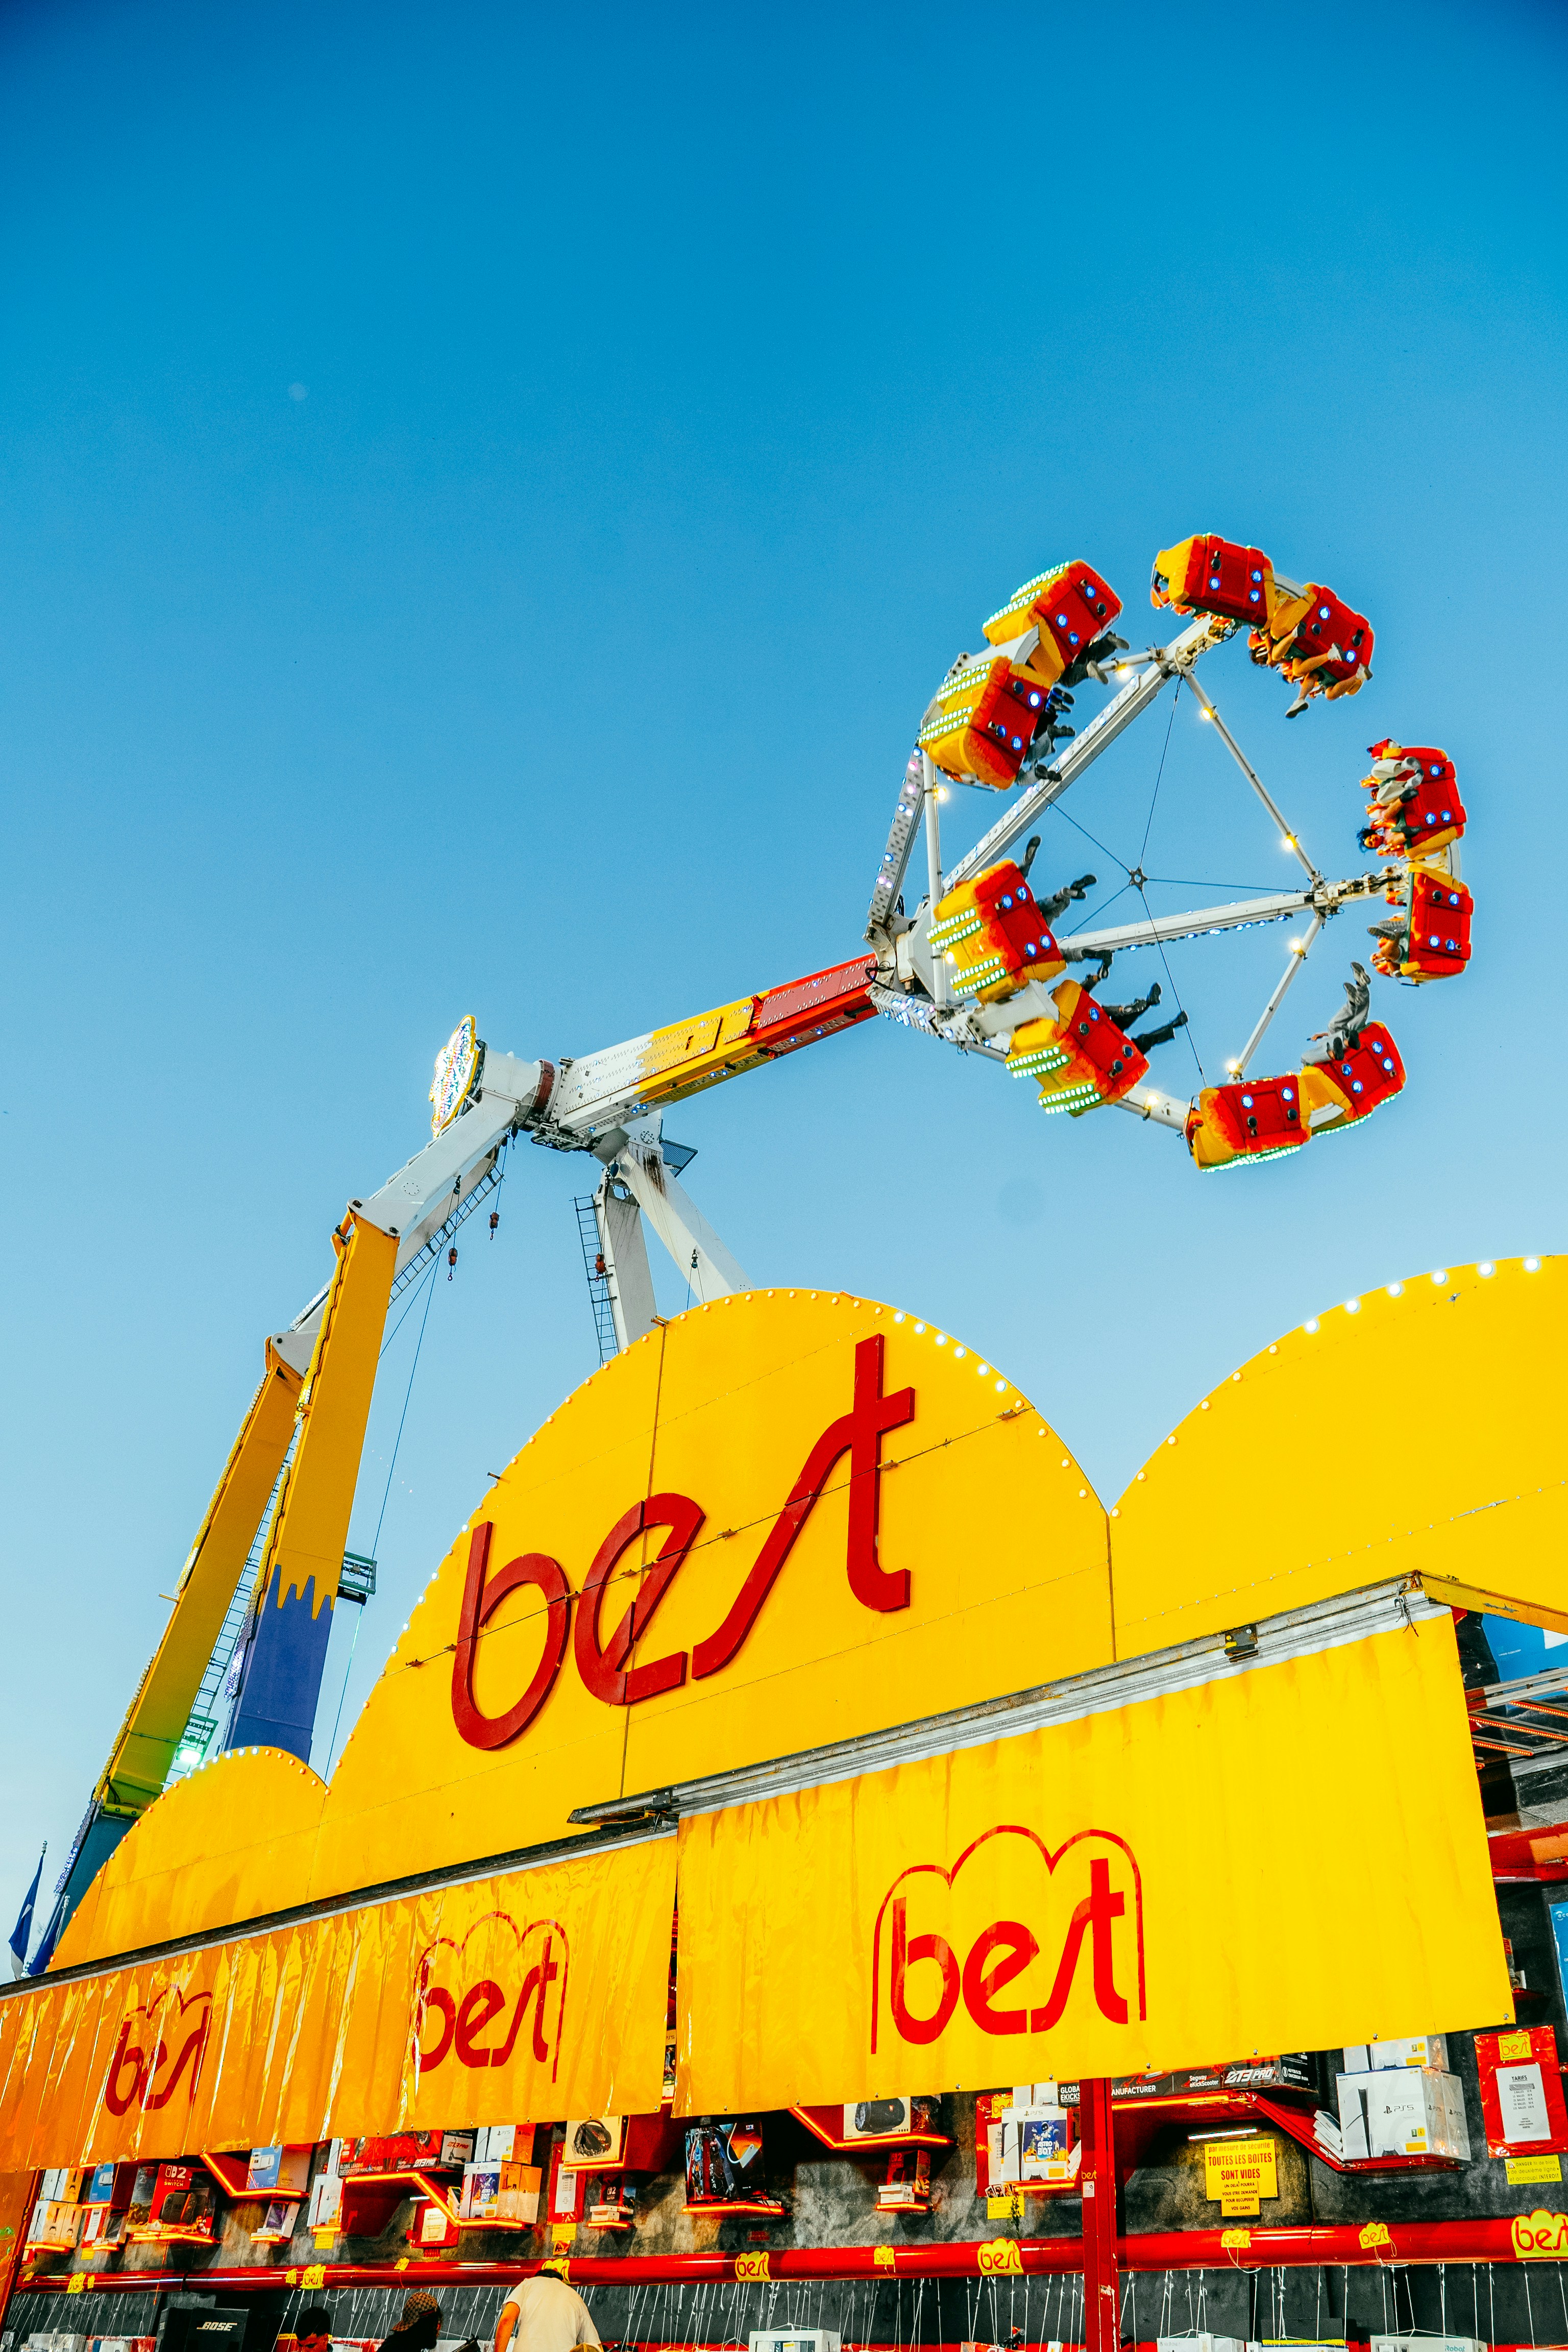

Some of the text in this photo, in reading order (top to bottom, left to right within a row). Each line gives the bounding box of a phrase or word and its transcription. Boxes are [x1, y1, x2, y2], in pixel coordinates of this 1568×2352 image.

[451, 1333, 915, 1750] best
[891, 1858, 1128, 2045] best
[412, 1935, 557, 2072] best
[1501, 2038, 1529, 2055] best
[1252, 2068, 1273, 2079] PRO
[1190, 2079, 1218, 2088] eKickScooter
[1061, 2085, 1156, 2101] EKICKS ANUFACTURER
[1038, 2147, 1052, 2155] BOT
[1208, 2152, 1272, 2166] TOUTES LES BOITES
[1082, 2170, 1096, 2179] best
[1221, 2169, 1260, 2180] SONT VIDES
[1223, 2232, 1247, 2245] best
[1361, 2225, 1387, 2245] best
[876, 2249, 892, 2262] best
[981, 2244, 1020, 2270] best
[737, 2255, 768, 2276] best
[305, 2268, 324, 2286] best
[197, 2322, 237, 2331] BOSE
